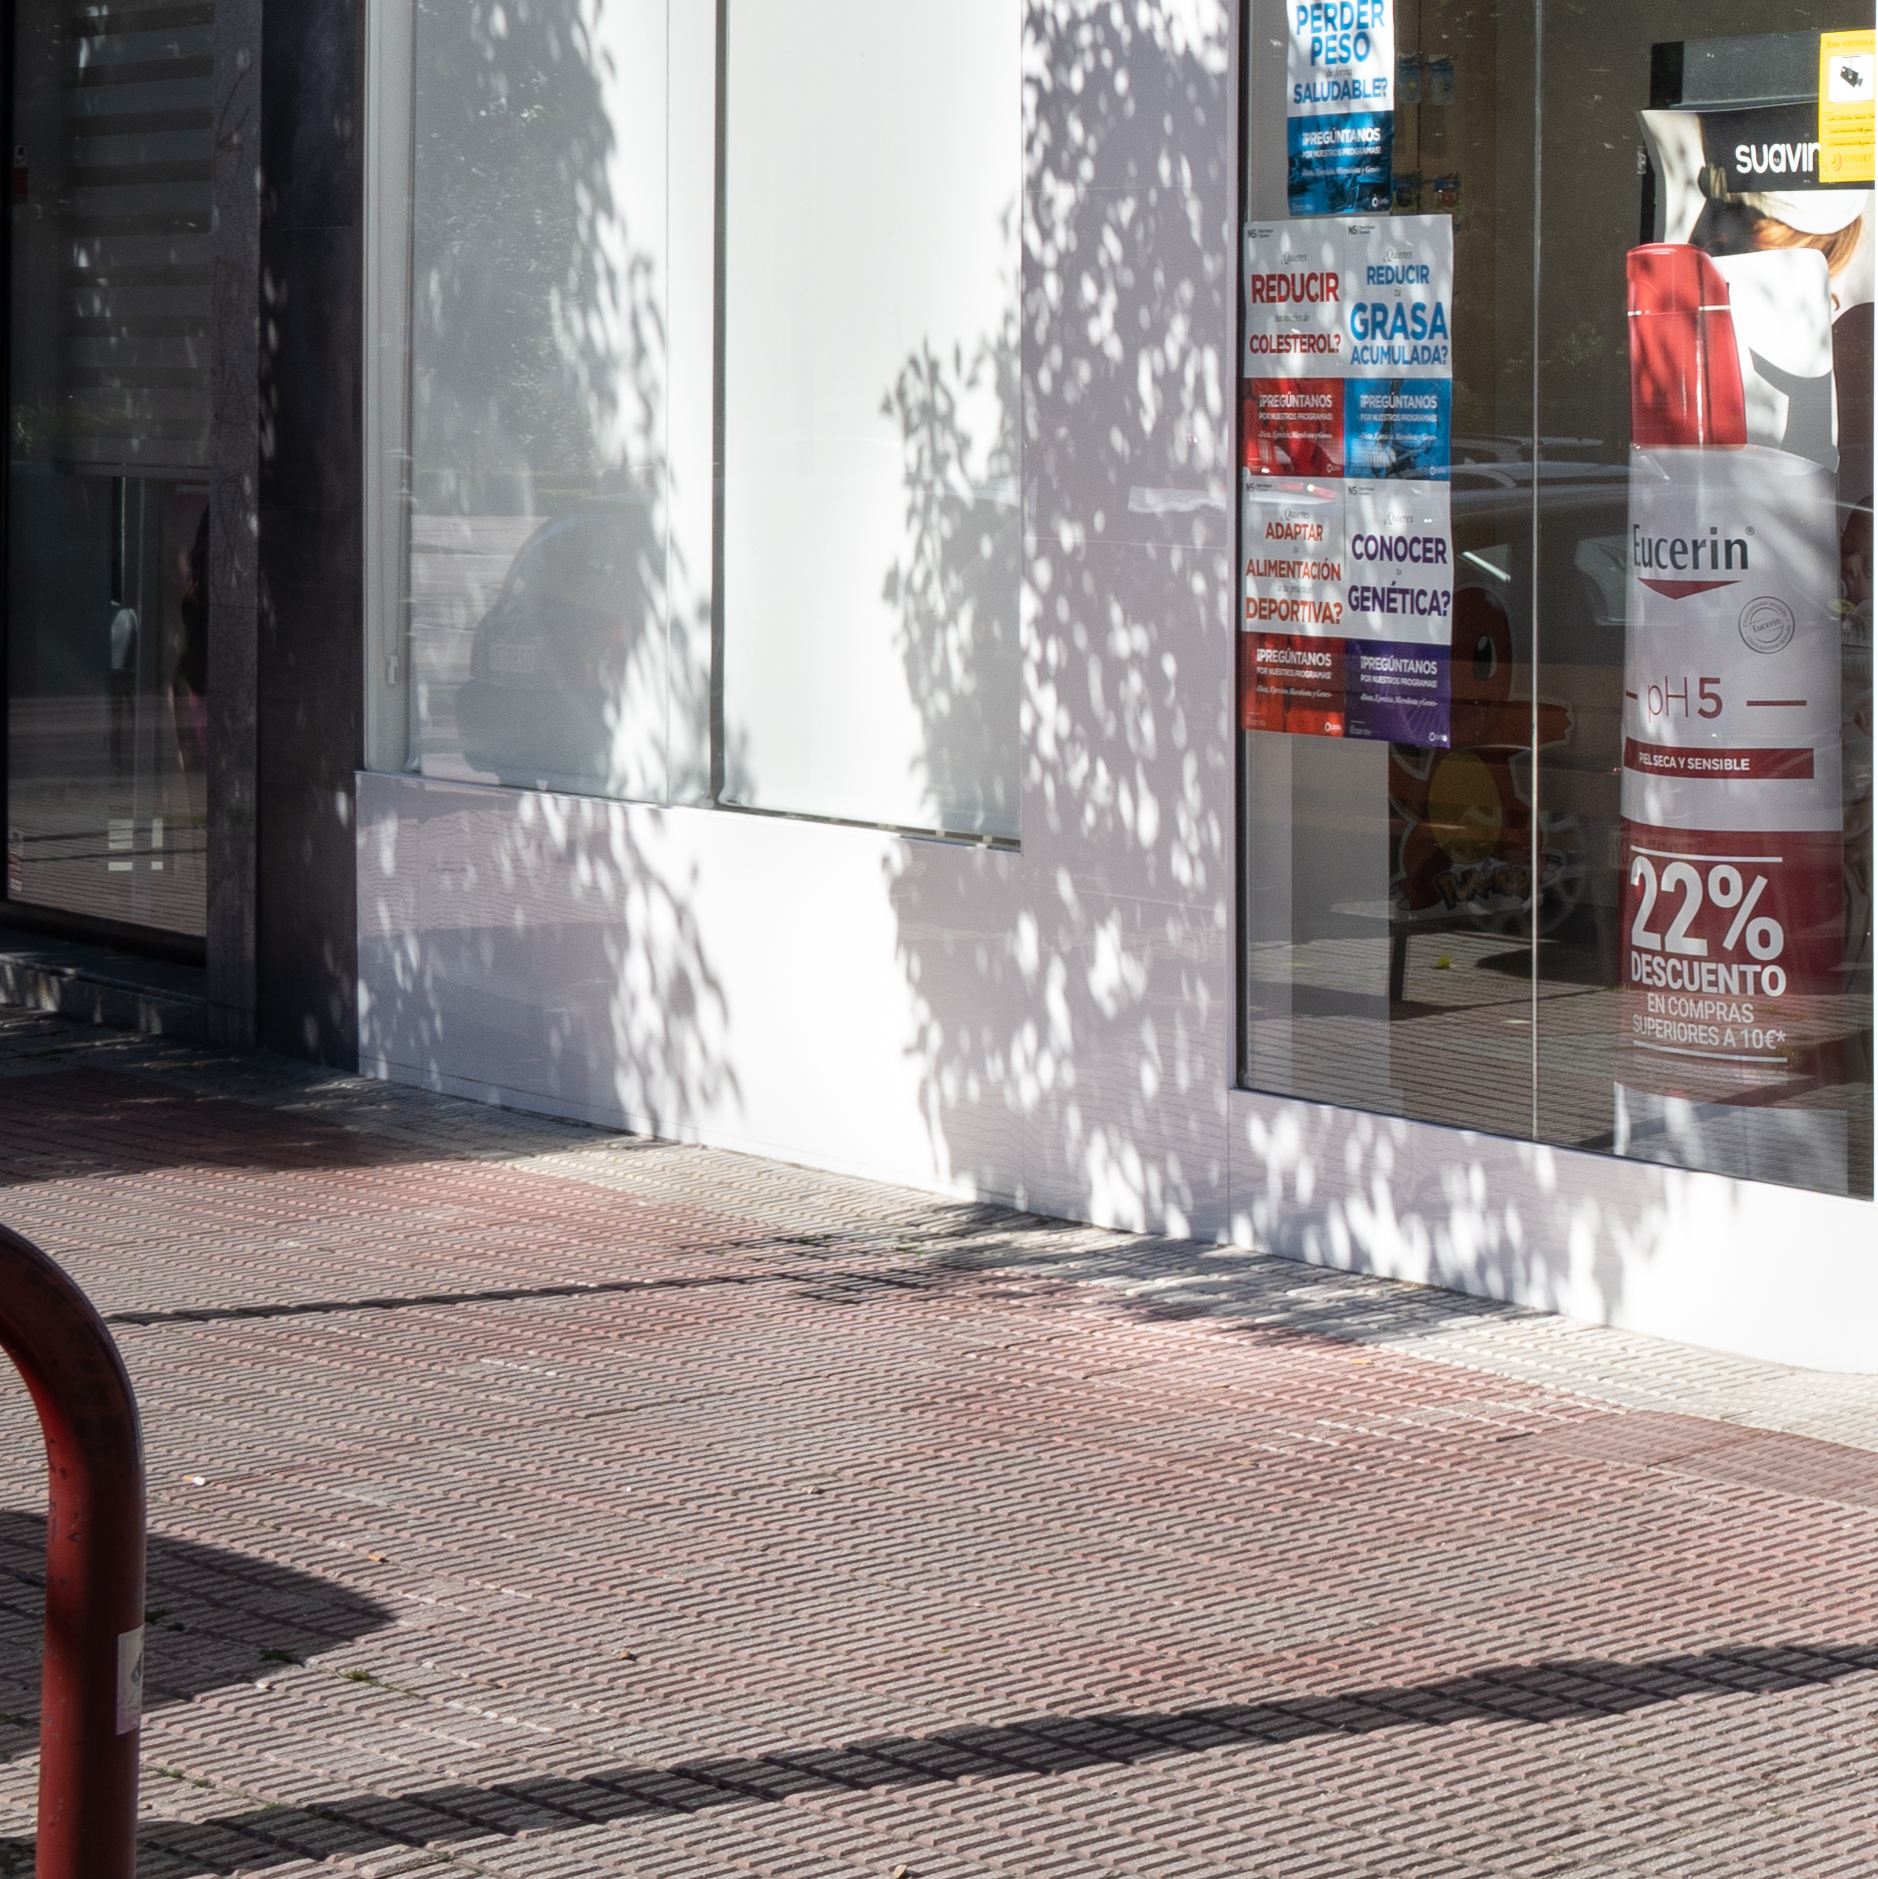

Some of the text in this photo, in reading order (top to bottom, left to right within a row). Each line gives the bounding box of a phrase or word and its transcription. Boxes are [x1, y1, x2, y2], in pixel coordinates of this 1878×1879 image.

[1310, 31, 1371, 67] PESO
[1293, 76, 1388, 105] SALUDABLE?
[1251, 272, 1340, 304] REDUCIR
[1366, 265, 1430, 285] REDUCIR
[1350, 302, 1449, 341] GRASA
[1249, 333, 1341, 354] COLESTEROL?
[1350, 344, 1449, 366] ACUMULADA?
[1265, 521, 1324, 542] ADAPTAR
[1352, 533, 1448, 564] CONOCER
[1245, 557, 1341, 581] ALIMENTACIÓN
[1245, 597, 1343, 625] DEPORTIVA?
[1348, 581, 1451, 617] GENÉTICA?
[1752, 616, 1781, 634] Eucerin
[1638, 751, 1750, 771] PIEL SECA Y SENSIBLE
[1630, 855, 1785, 961] 22%
[1631, 950, 1787, 998] DESCUENTO
[1647, 992, 1754, 1024] EN COMPRAS
[1633, 1013, 1719, 1047] SUPERIORES
[1723, 1027, 1737, 1048] A
